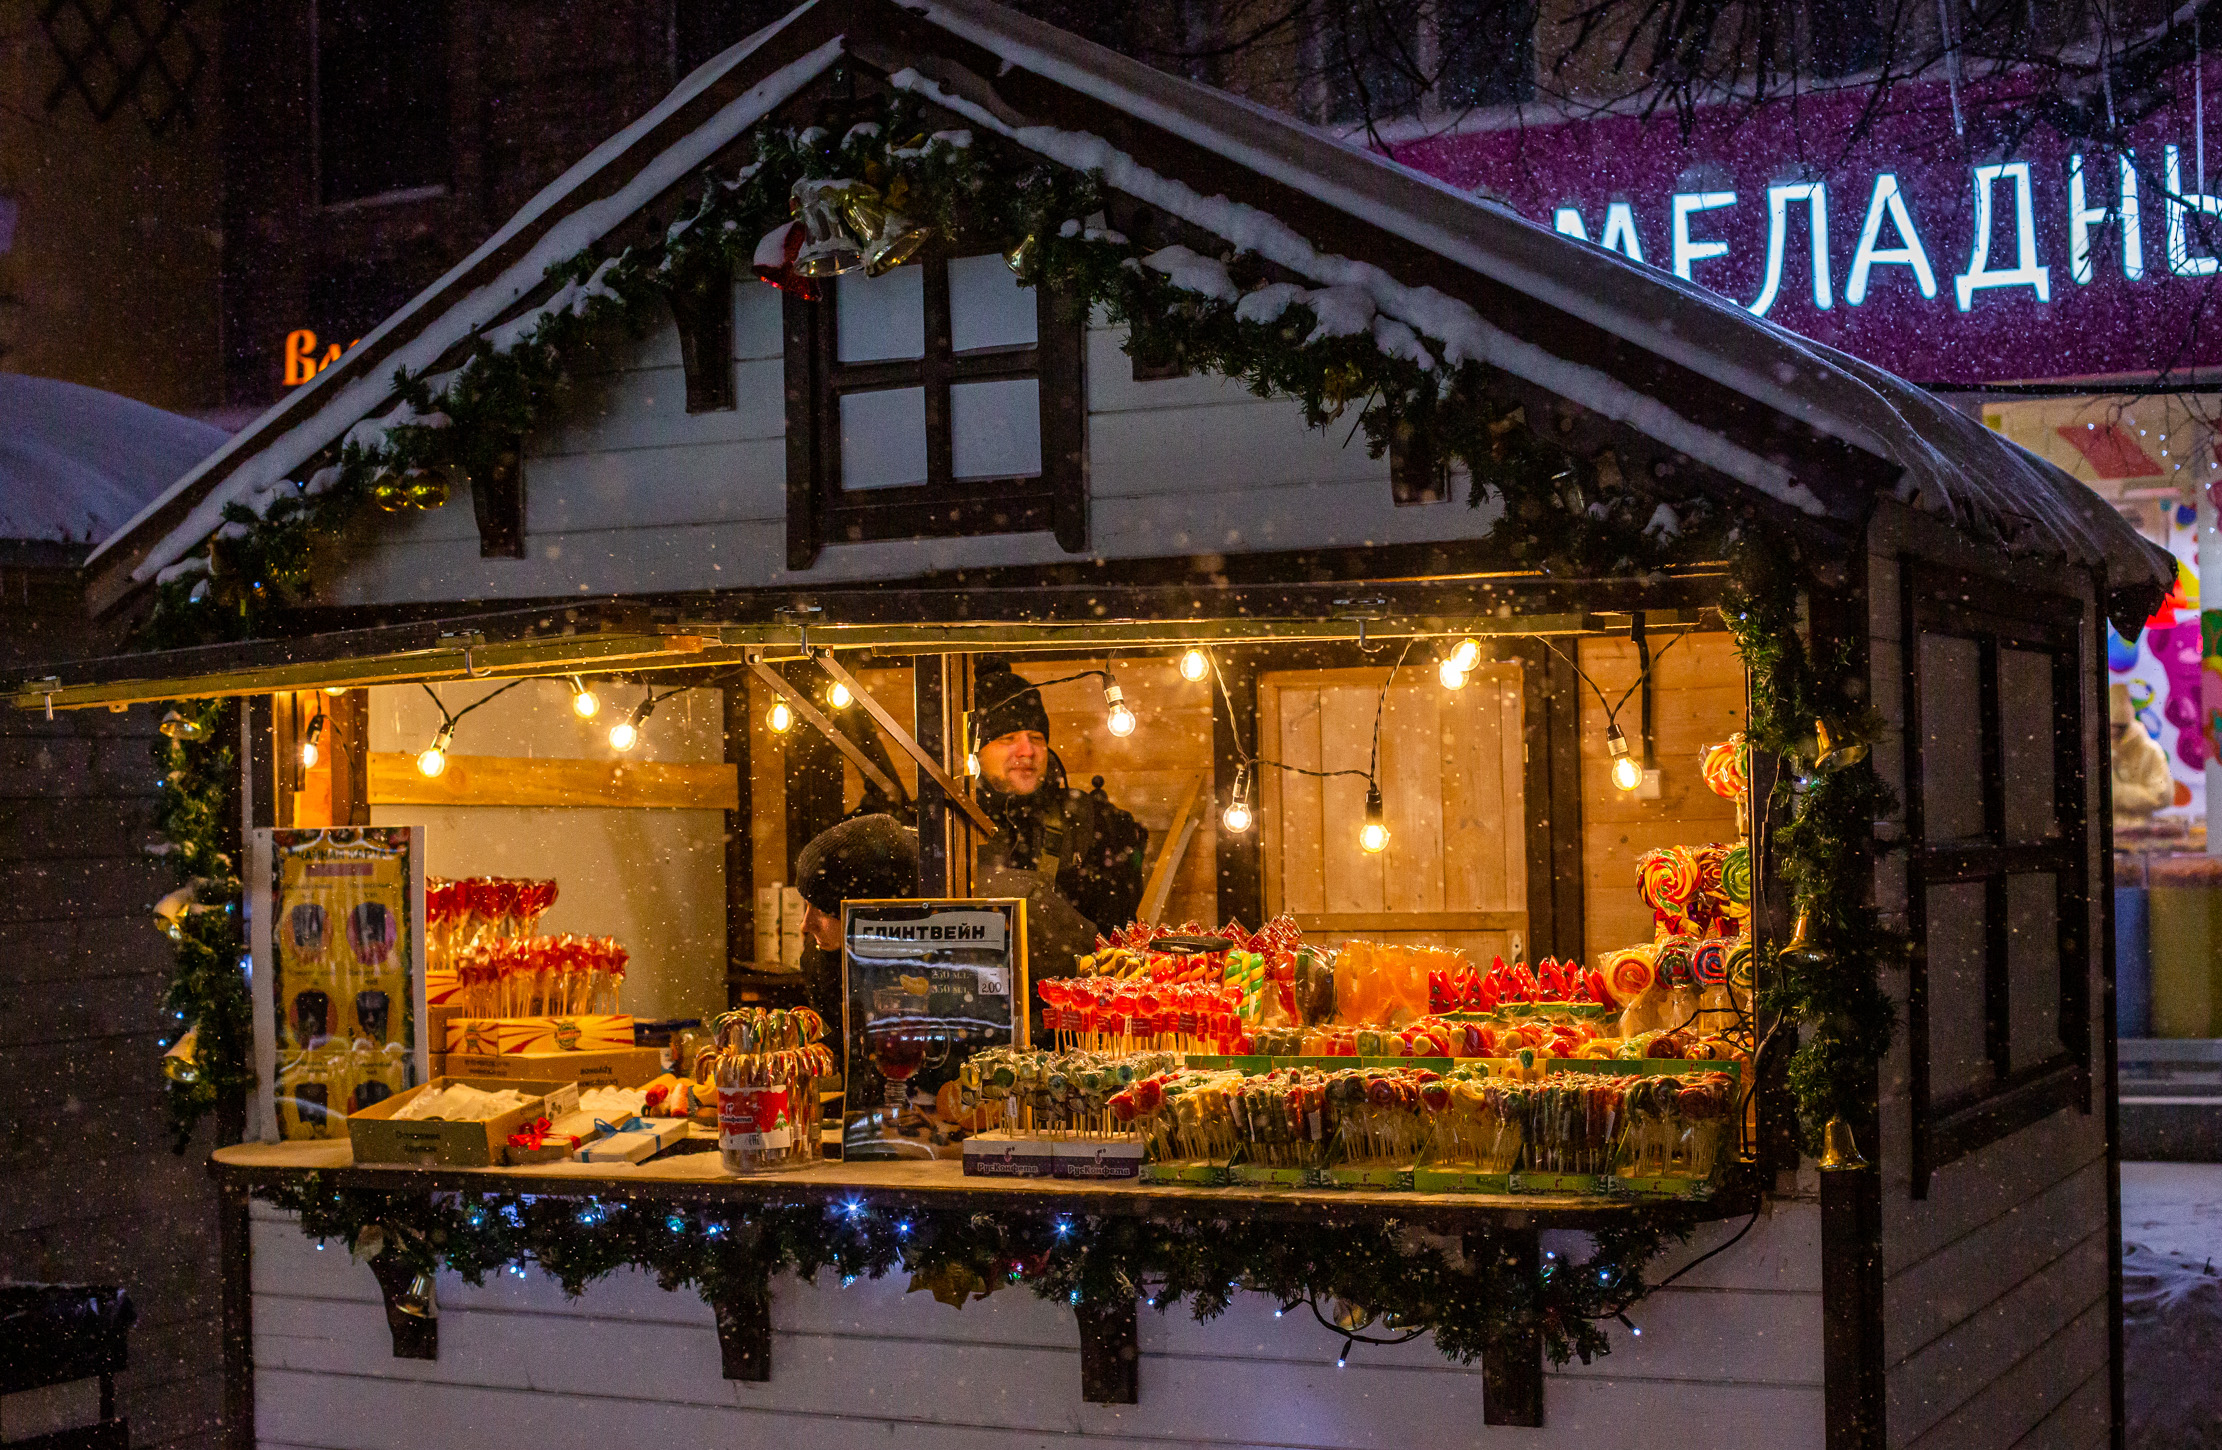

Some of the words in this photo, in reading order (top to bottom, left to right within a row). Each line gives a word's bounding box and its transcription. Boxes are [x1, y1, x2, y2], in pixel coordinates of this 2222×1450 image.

[862, 922, 985, 940] ГЛИНТВЕЙН
[977, 1162, 1039, 1175] РусКонфета
[1067, 1164, 1131, 1178] РусКонфета
